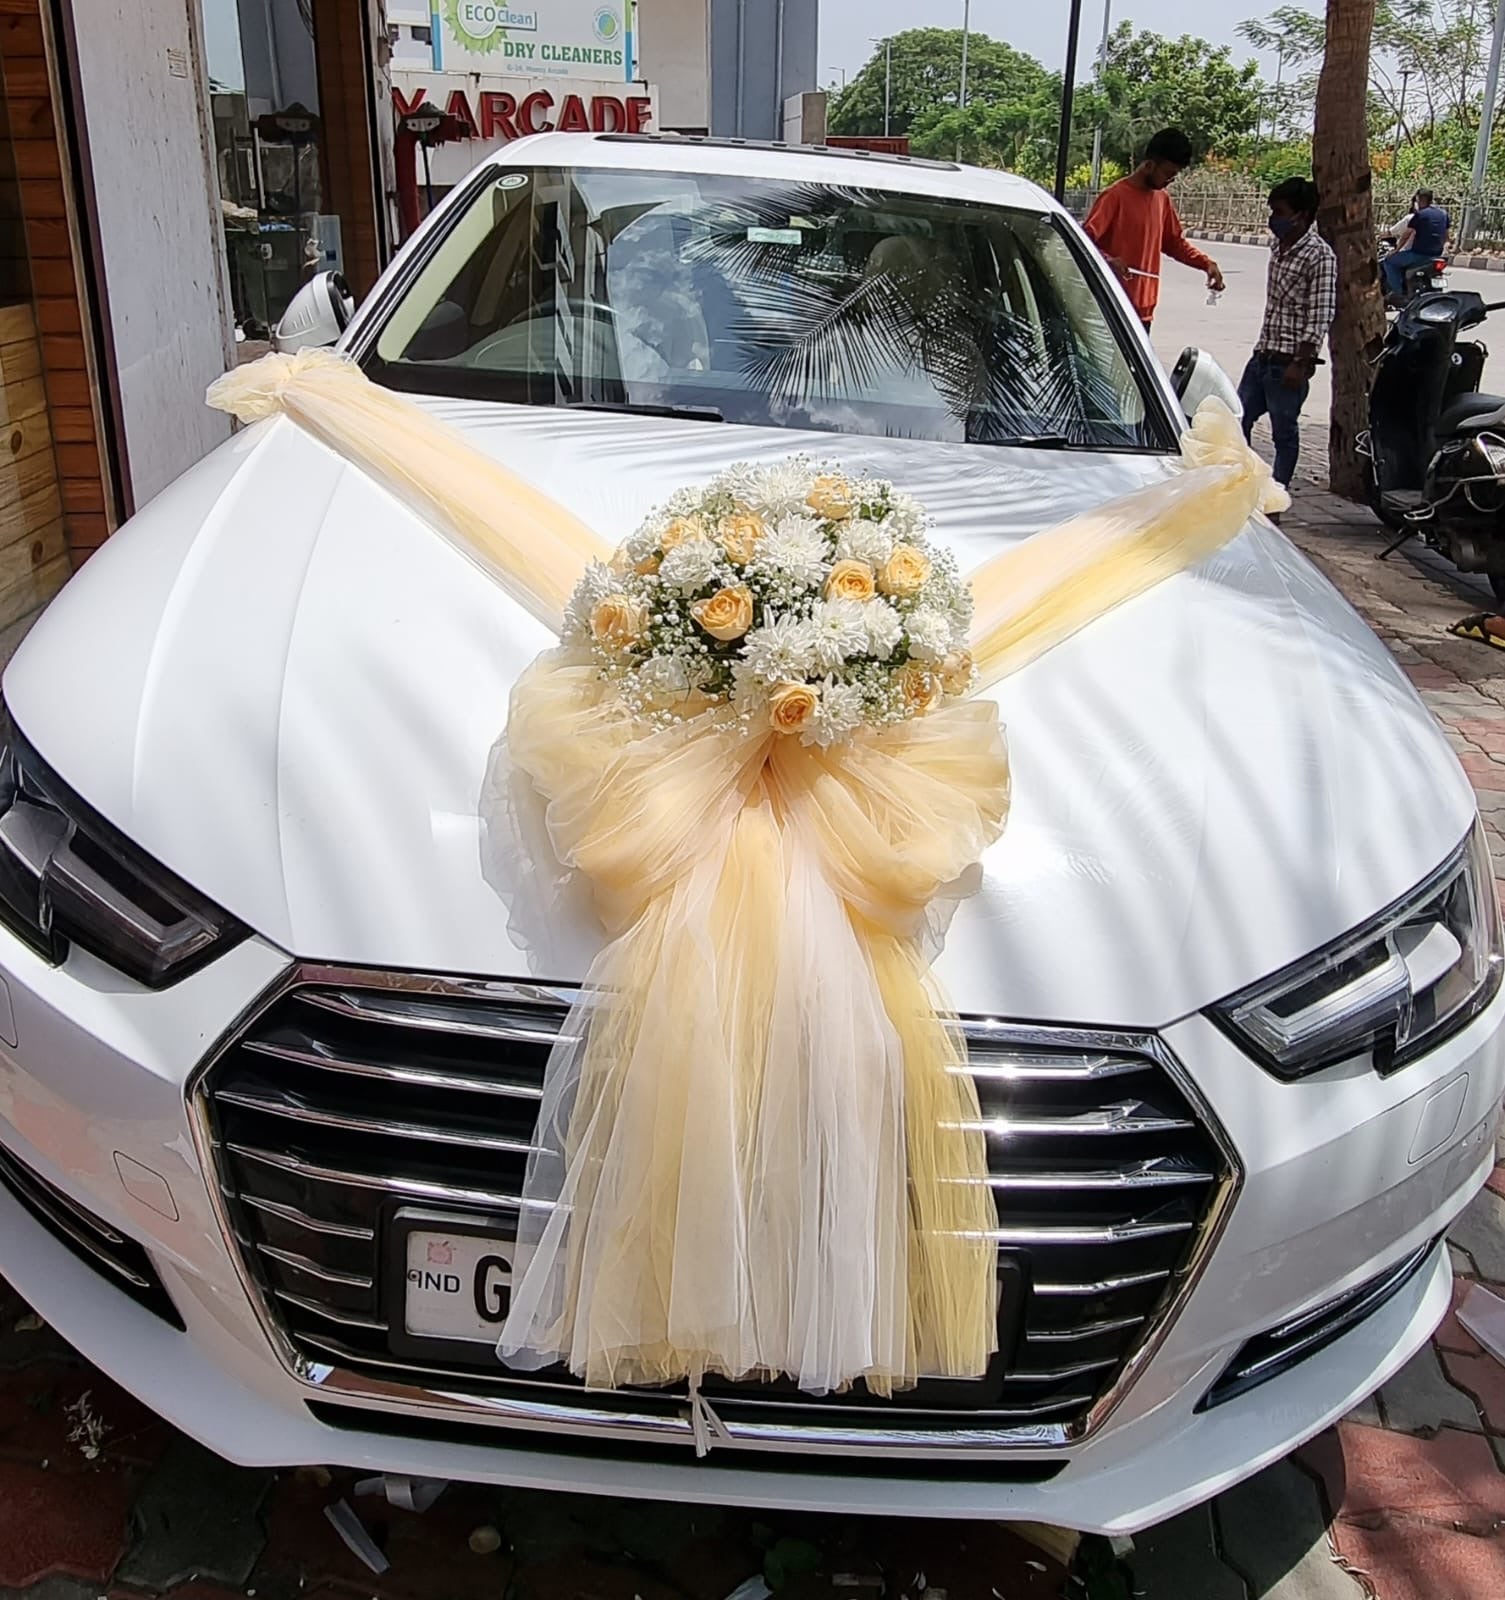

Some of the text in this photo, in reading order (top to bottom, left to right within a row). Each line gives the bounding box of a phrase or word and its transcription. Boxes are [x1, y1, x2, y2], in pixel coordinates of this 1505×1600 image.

[465, 4, 533, 25] ECO Clean
[503, 41, 623, 66] DRY CLEANERS
[445, 88, 652, 140] ARCADE
[416, 1270, 461, 1293] IND
